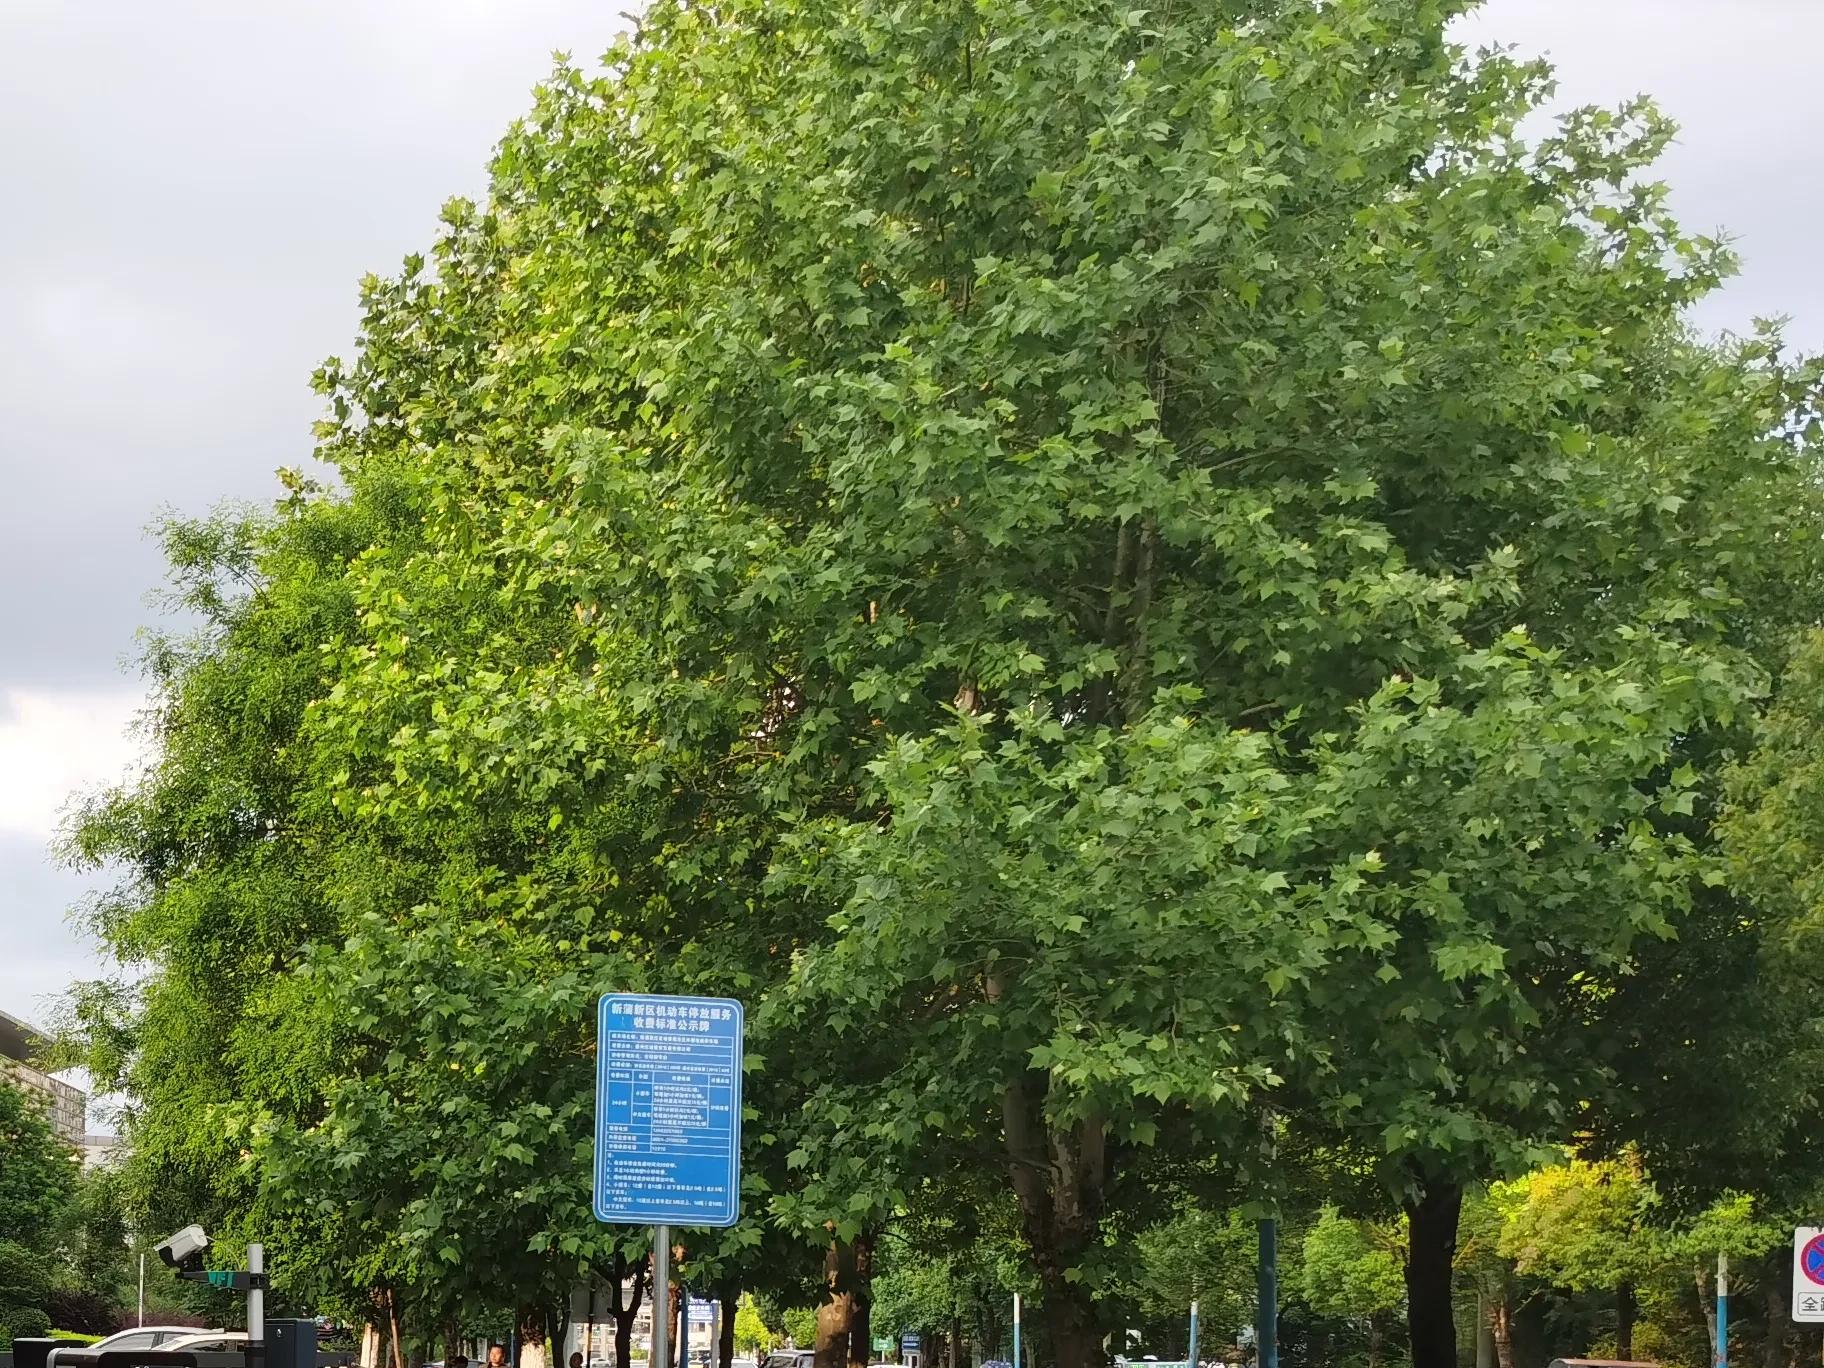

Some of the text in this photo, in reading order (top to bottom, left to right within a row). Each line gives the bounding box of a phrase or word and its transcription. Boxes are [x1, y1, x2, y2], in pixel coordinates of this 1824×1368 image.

[633, 1016, 710, 1032] 收费标准公示牌
